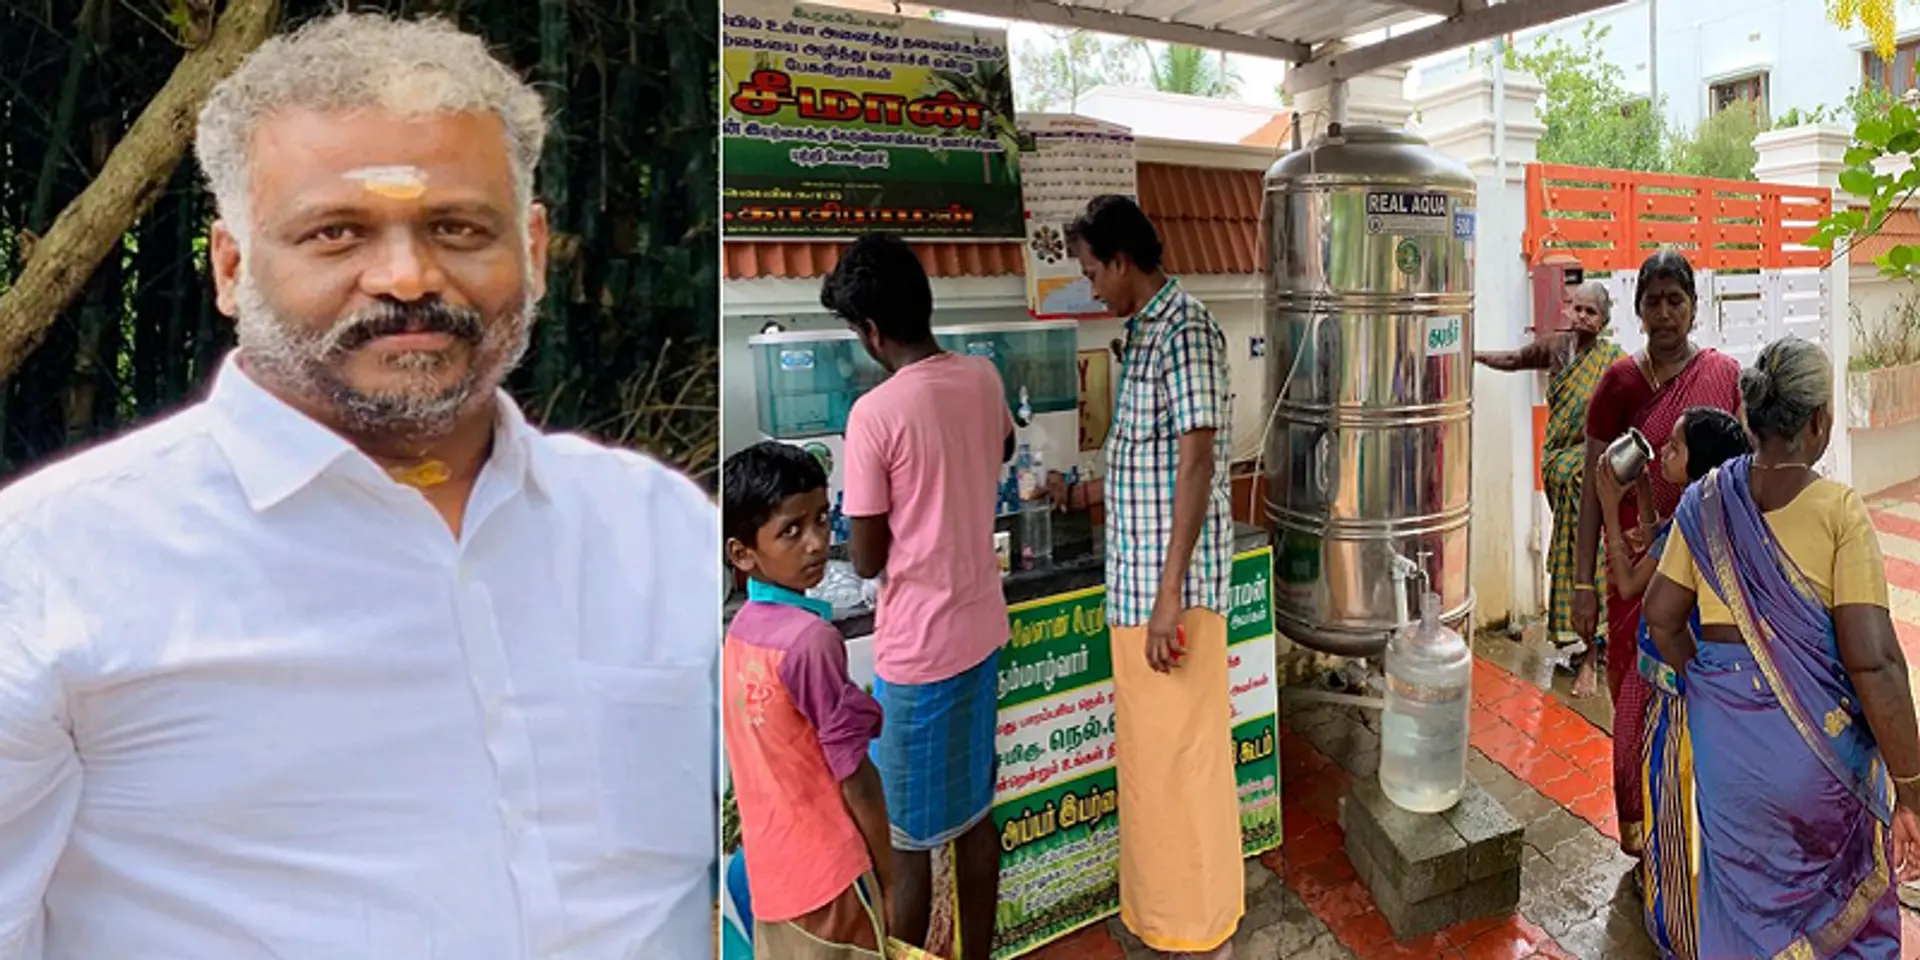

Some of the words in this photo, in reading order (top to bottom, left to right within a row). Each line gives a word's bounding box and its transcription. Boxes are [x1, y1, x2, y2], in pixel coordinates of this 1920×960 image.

[731, 69, 986, 130] சீமான்
[1367, 193, 1407, 212] REAL
[1411, 195, 1445, 214] AQUA
[997, 645, 1089, 699] நம்மாழ்வார்
